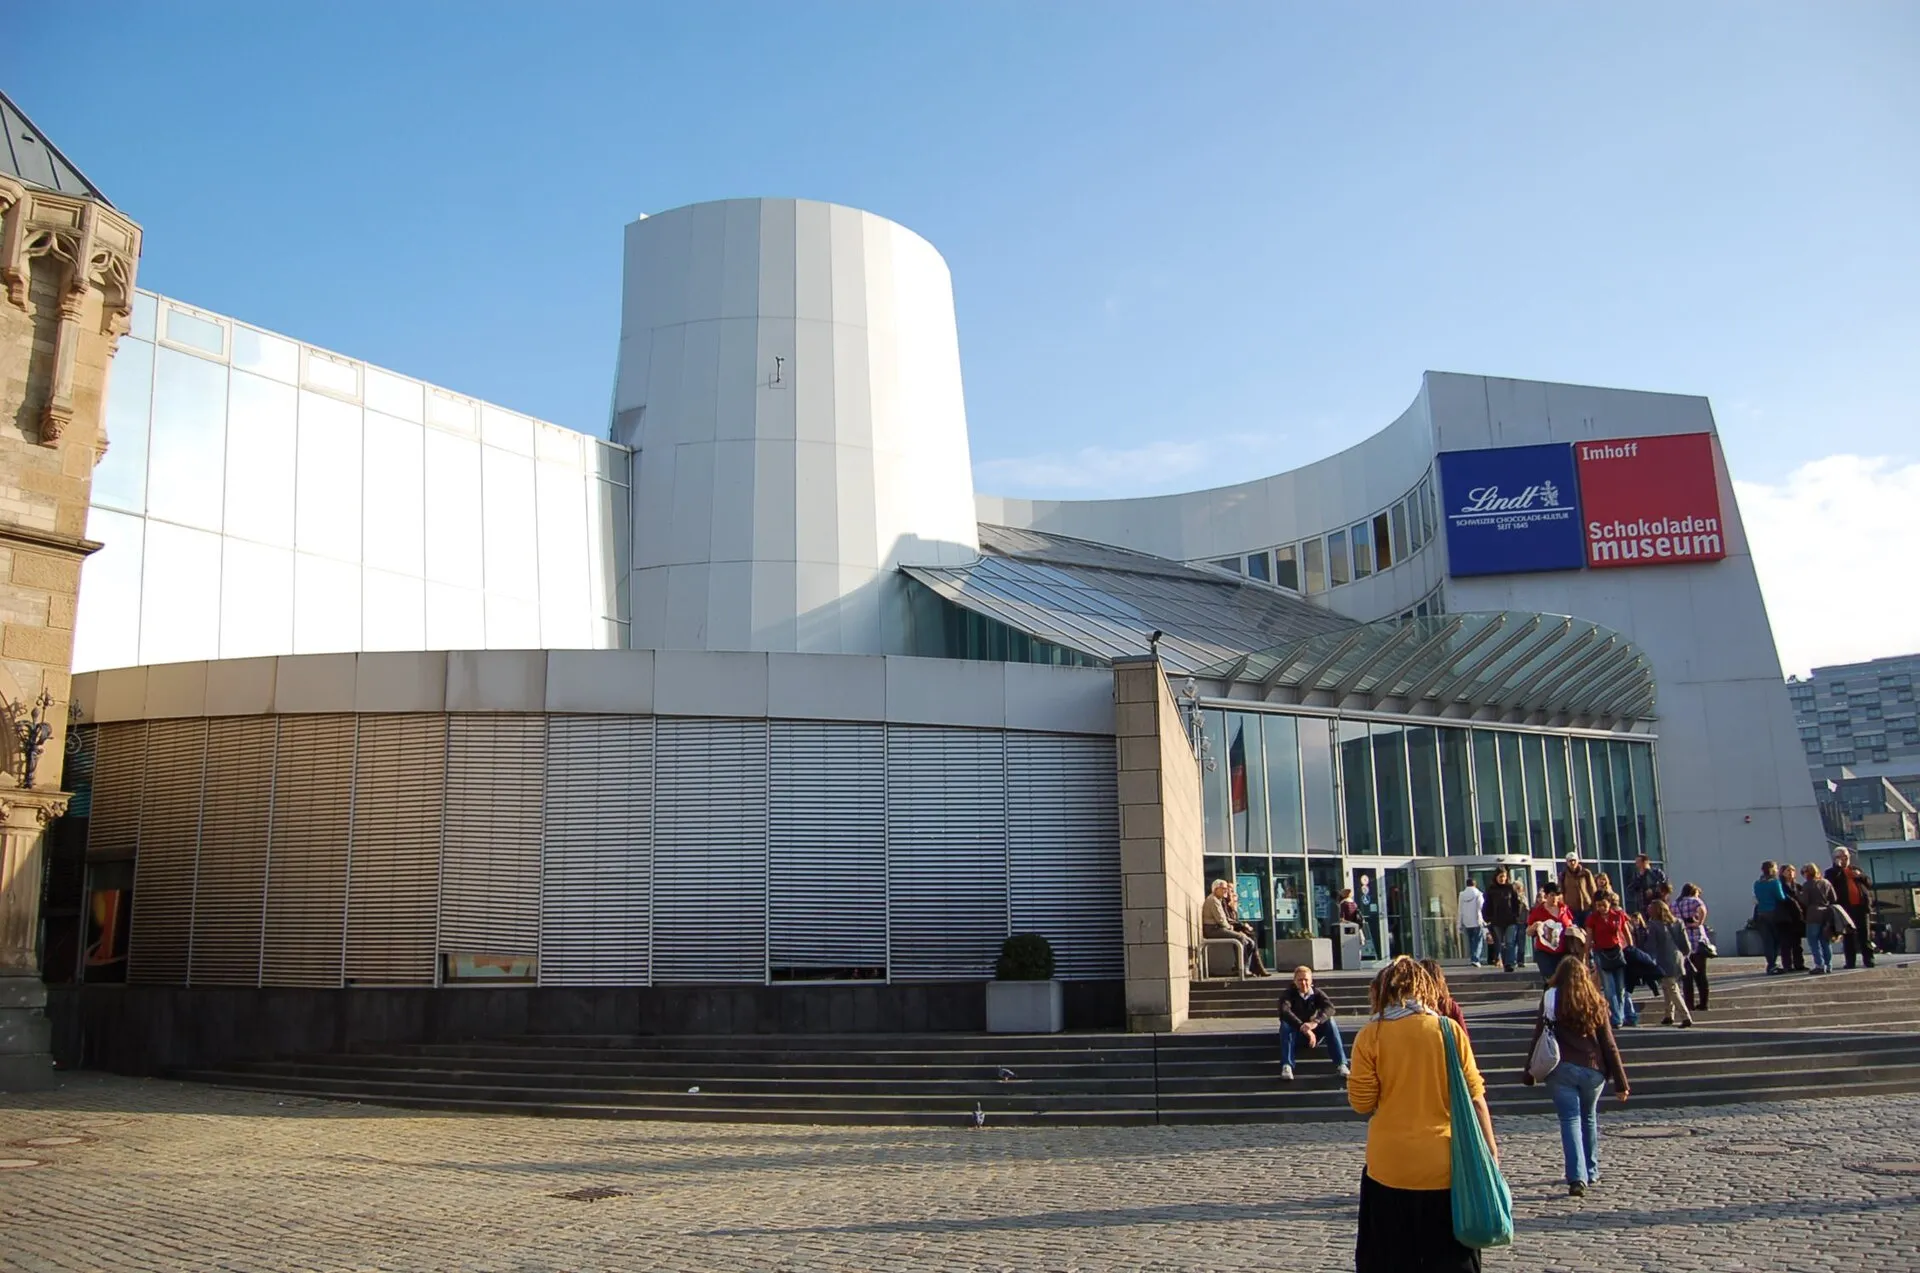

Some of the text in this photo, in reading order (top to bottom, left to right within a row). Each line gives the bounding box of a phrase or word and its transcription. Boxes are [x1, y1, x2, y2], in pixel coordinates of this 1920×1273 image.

[1582, 443, 1638, 461] Imhoff
[1461, 486, 1540, 513] Lindt
[1456, 517, 1495, 527] SCHWEIZER
[1497, 522, 1529, 531] SEIT 1845
[1588, 515, 1718, 540] Schokoladen
[1591, 533, 1721, 562] museum
